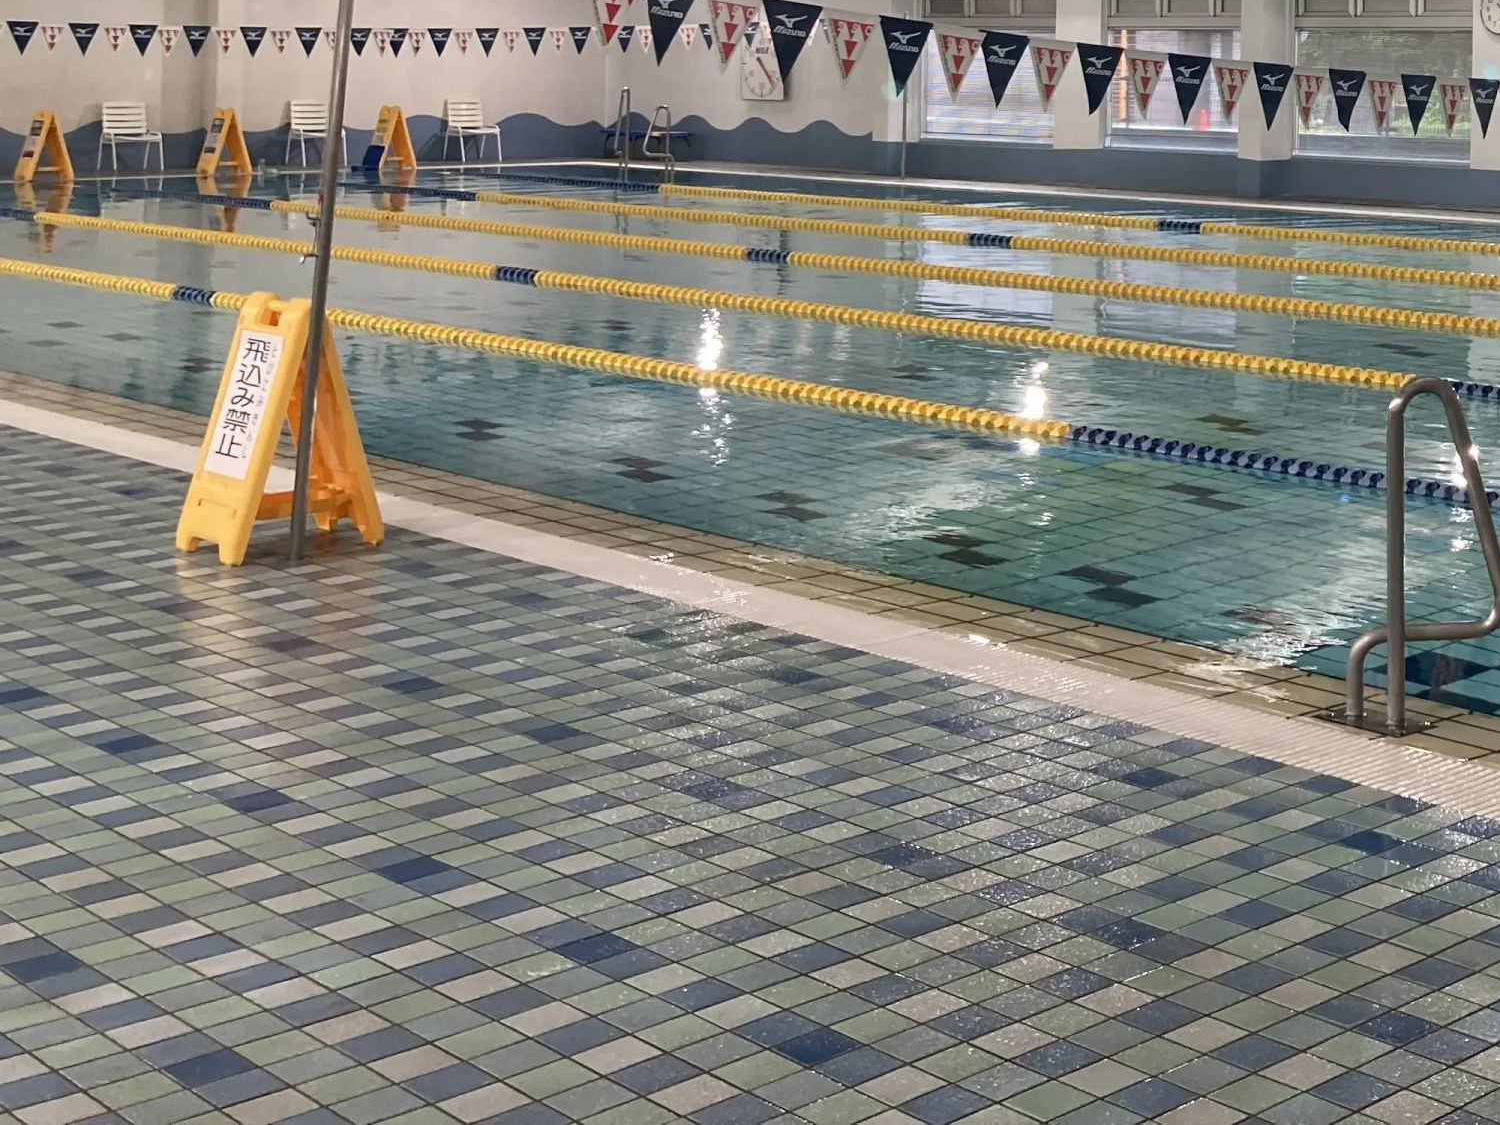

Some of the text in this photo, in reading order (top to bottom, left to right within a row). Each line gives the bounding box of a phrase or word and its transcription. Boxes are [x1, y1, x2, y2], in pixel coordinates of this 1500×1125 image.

[215, 338, 271, 459] 飛込み禁止
